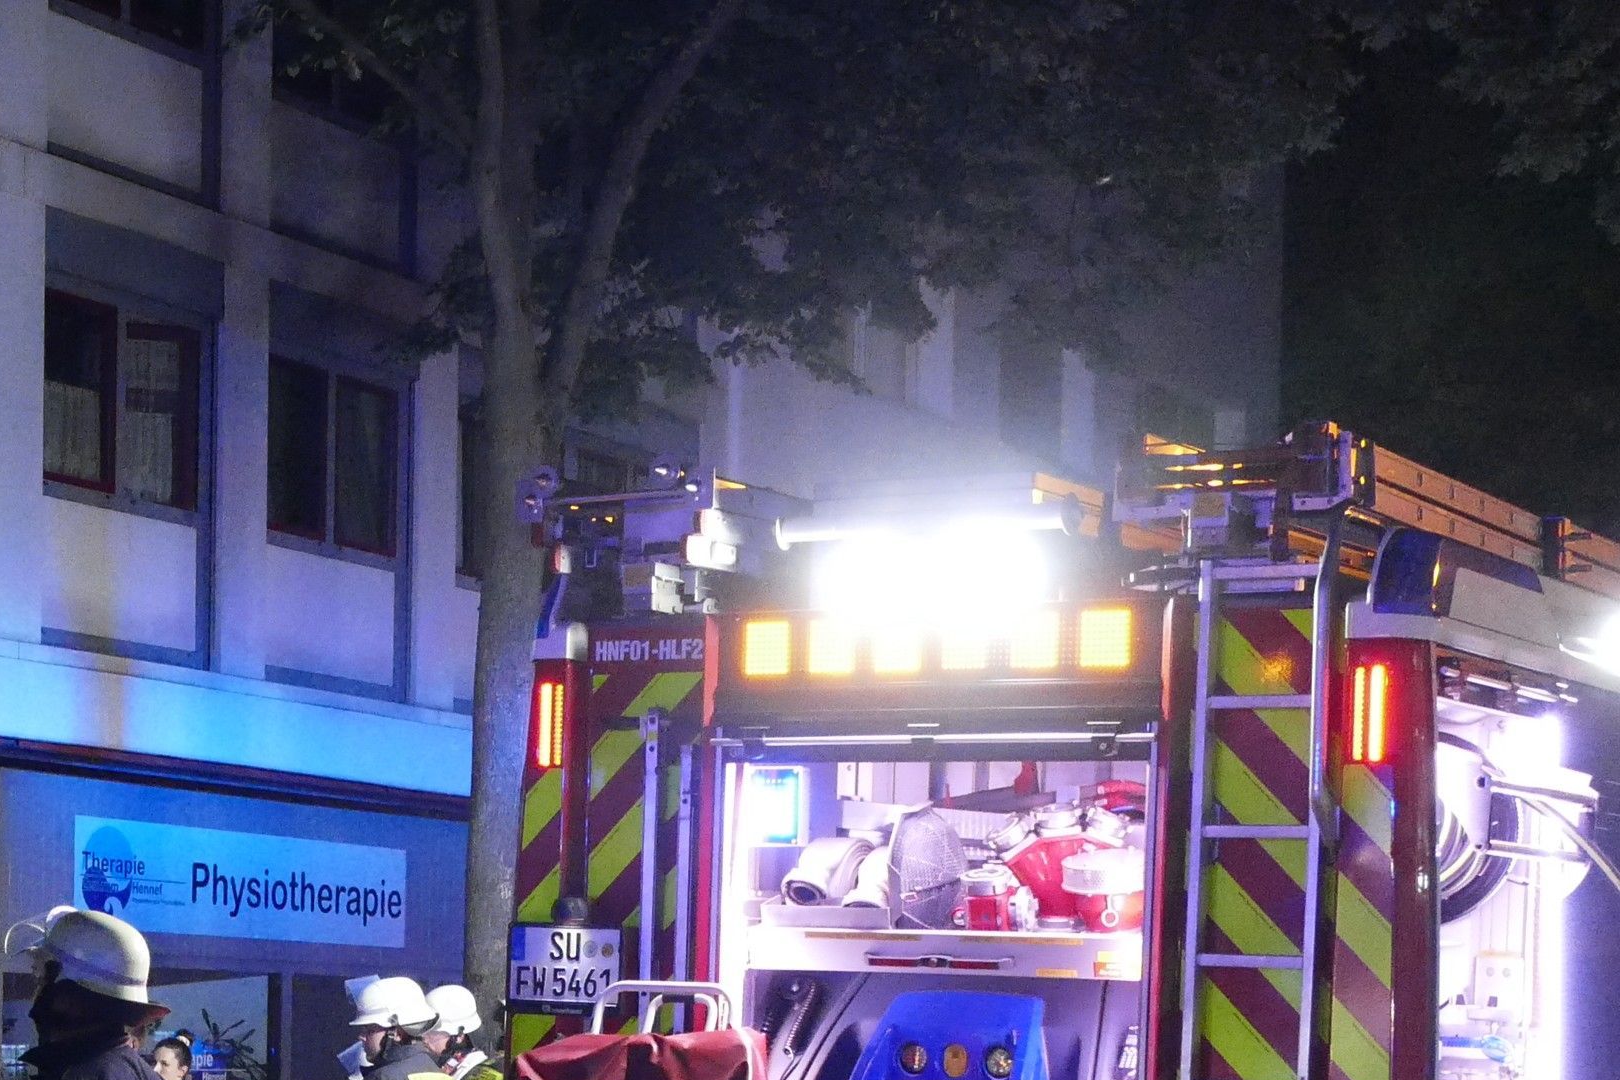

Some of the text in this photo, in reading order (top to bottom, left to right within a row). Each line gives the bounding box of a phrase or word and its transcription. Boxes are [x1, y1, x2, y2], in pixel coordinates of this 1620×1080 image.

[82, 851, 145, 878] Therapie
[132, 881, 163, 896] Hennef
[191, 861, 402, 927] Physiotherapie
[549, 931, 582, 961] SU
[516, 966, 611, 998] FW 5461
